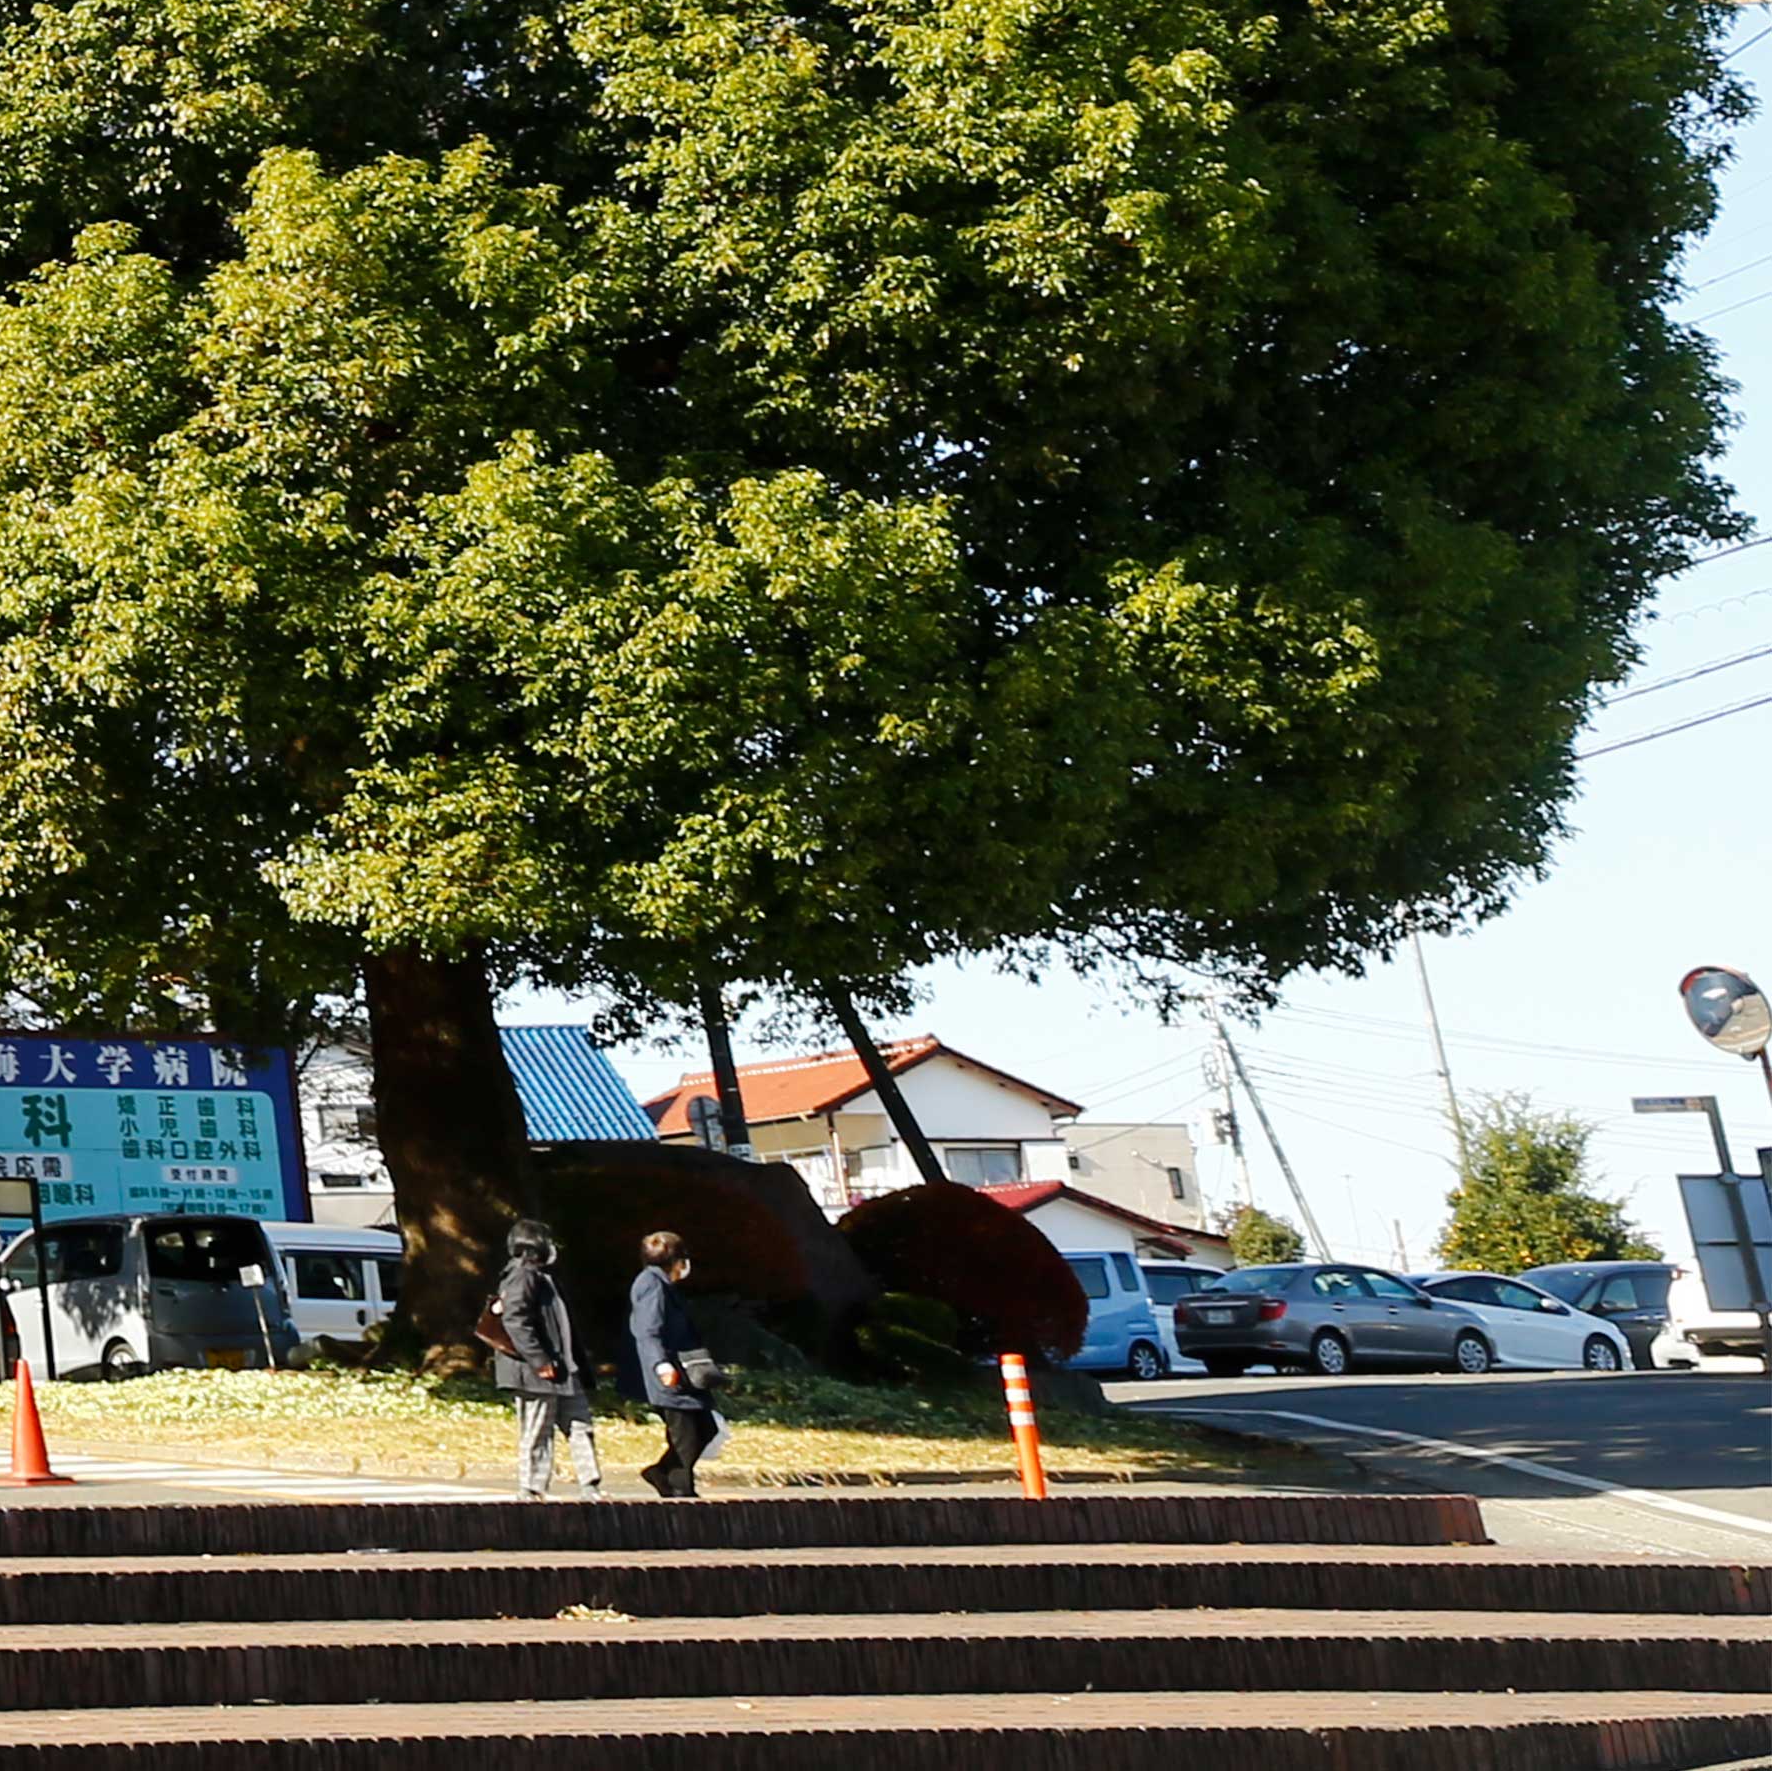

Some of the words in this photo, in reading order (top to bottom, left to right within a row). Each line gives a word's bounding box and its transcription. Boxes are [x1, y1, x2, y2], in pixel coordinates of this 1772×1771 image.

[119, 1117, 258, 1139] 小児歯科
[122, 1139, 262, 1162] 歯科口腔外科
